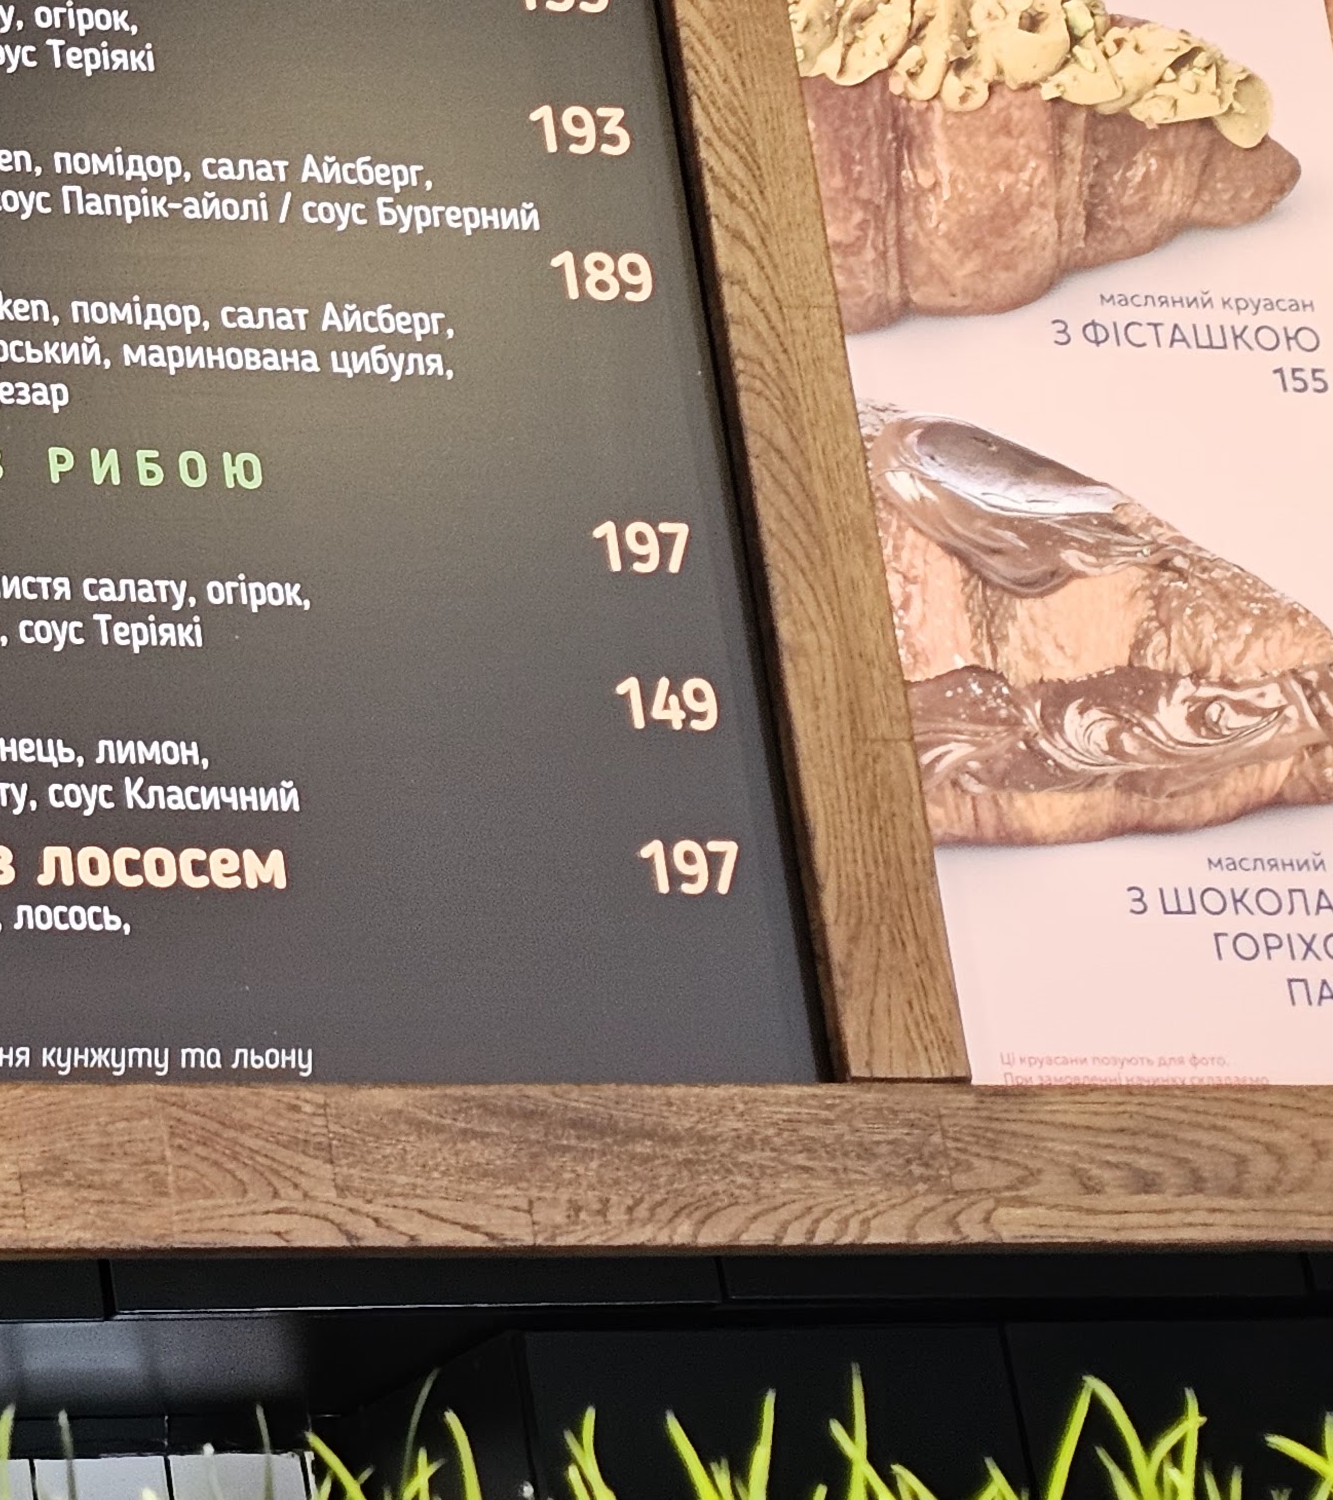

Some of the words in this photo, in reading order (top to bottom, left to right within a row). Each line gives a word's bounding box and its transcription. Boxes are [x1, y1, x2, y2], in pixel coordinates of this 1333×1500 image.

[528, 103, 632, 157] 193
[60, 184, 270, 225] Папрік-айолі
[301, 200, 369, 232] соус
[375, 195, 541, 237] Бургерний
[549, 249, 654, 303] 189
[1099, 289, 1215, 310] масляний
[1221, 295, 1316, 316] круасан
[1050, 318, 1072, 347] З
[1081, 318, 1321, 353] ФІСТАШКОЮ
[1271, 366, 1330, 394] 155
[46, 445, 264, 491] РИБОЮ
[591, 519, 691, 575] 197
[614, 675, 719, 733] 149
[47, 782, 116, 818] соус
[123, 775, 301, 813] Класичний
[35, 844, 288, 891] лососем
[638, 838, 740, 896] 197
[1206, 851, 1328, 873] масляний
[1126, 885, 1149, 916] З
[40, 1045, 170, 1078] кунжуту
[179, 1046, 223, 1071] та
[229, 1046, 314, 1079] льону
